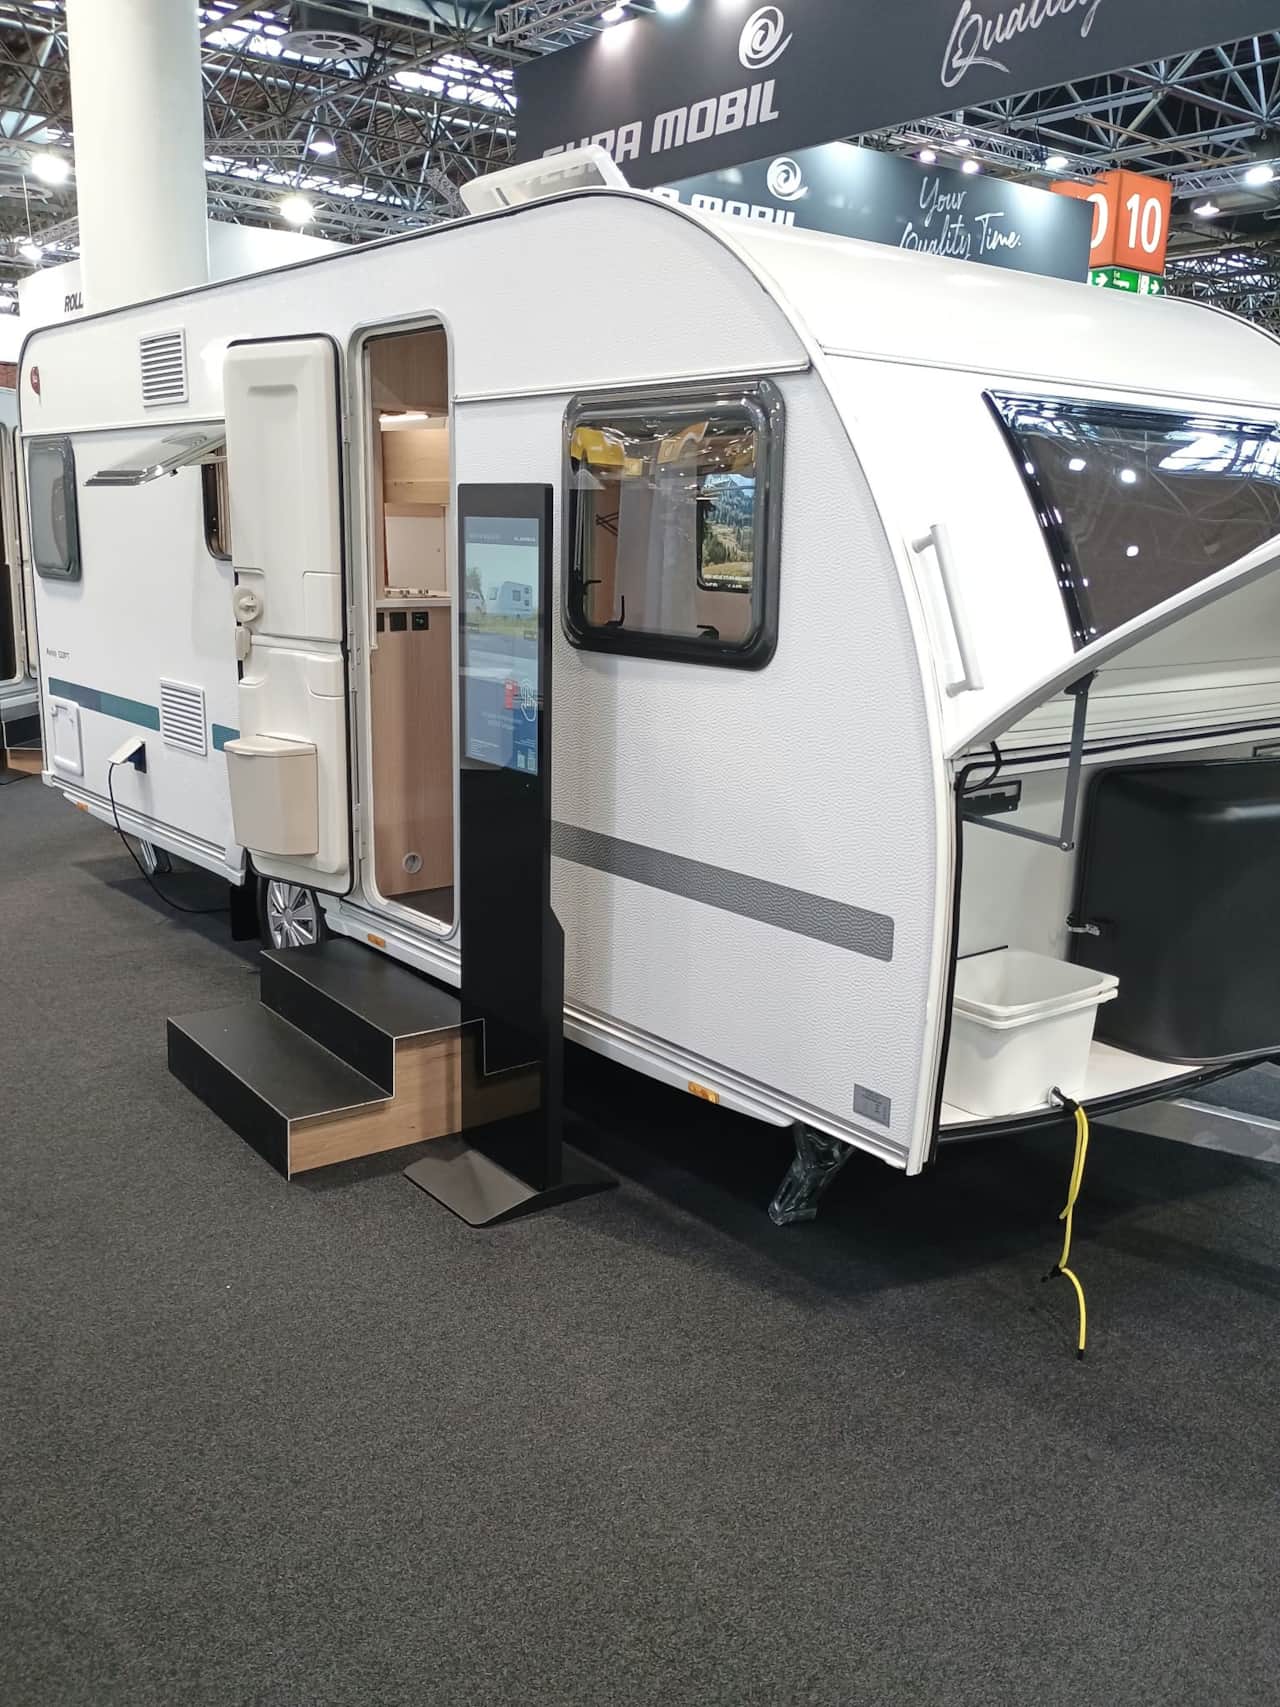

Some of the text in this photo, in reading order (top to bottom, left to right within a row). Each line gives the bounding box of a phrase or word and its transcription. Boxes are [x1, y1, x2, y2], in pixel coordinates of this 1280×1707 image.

[650, 79, 779, 154] MOBIL
[919, 176, 967, 227] Your
[1126, 193, 1162, 253] 10
